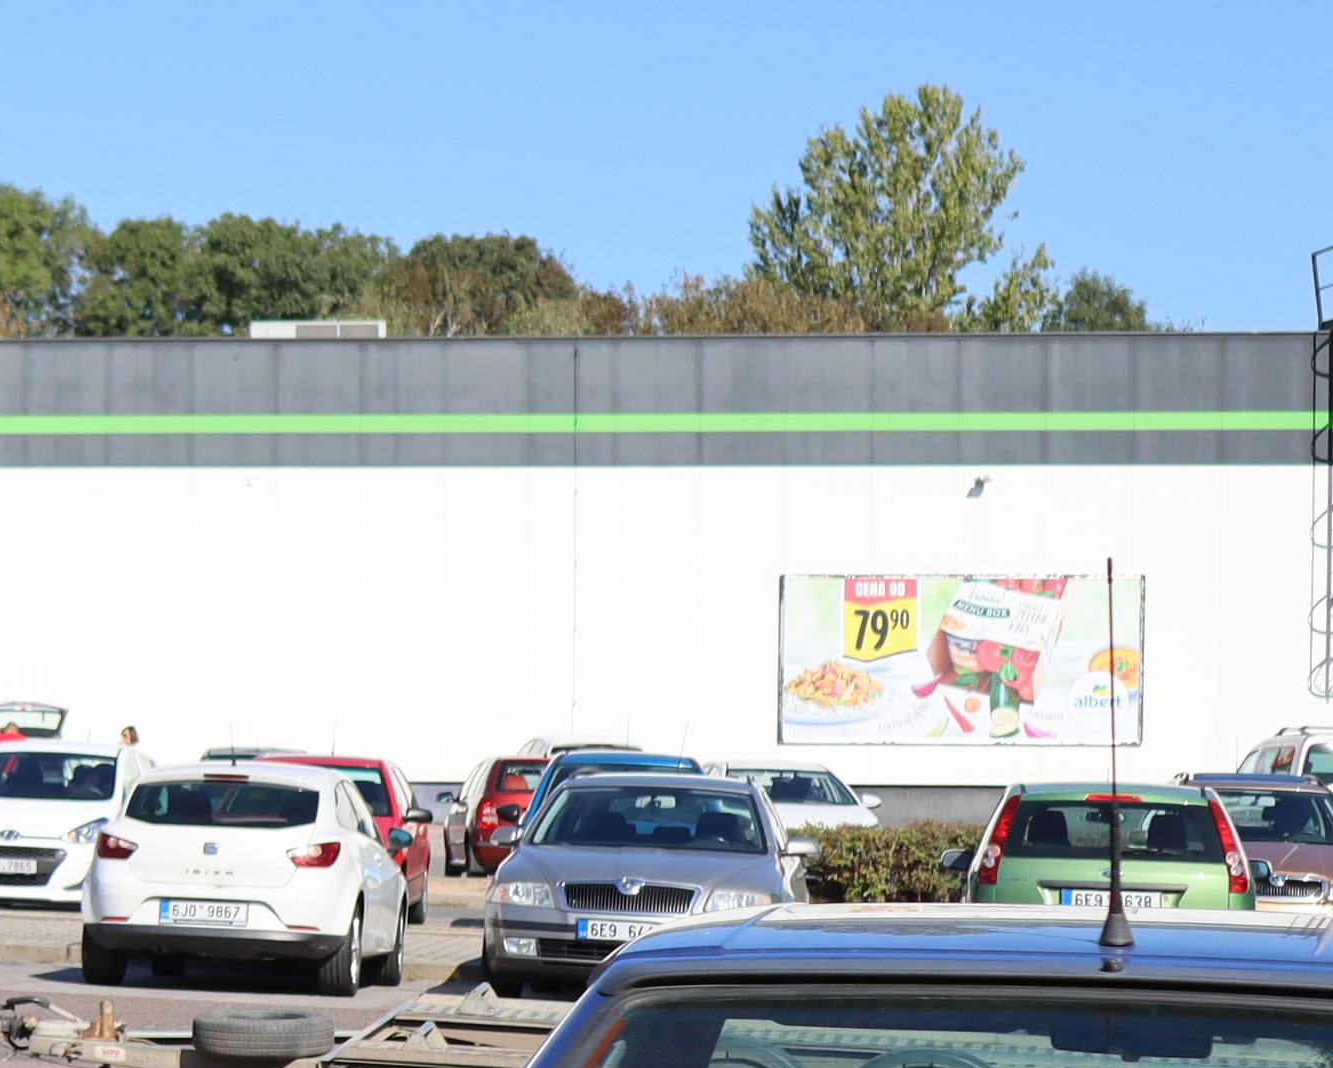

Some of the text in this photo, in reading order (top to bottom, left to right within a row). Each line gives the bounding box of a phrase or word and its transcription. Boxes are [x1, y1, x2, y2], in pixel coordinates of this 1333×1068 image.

[854, 580, 906, 597] CENA OD
[955, 600, 984, 615] MENU
[207, 905, 241, 919] 9867
[590, 923, 617, 938] 6E9
